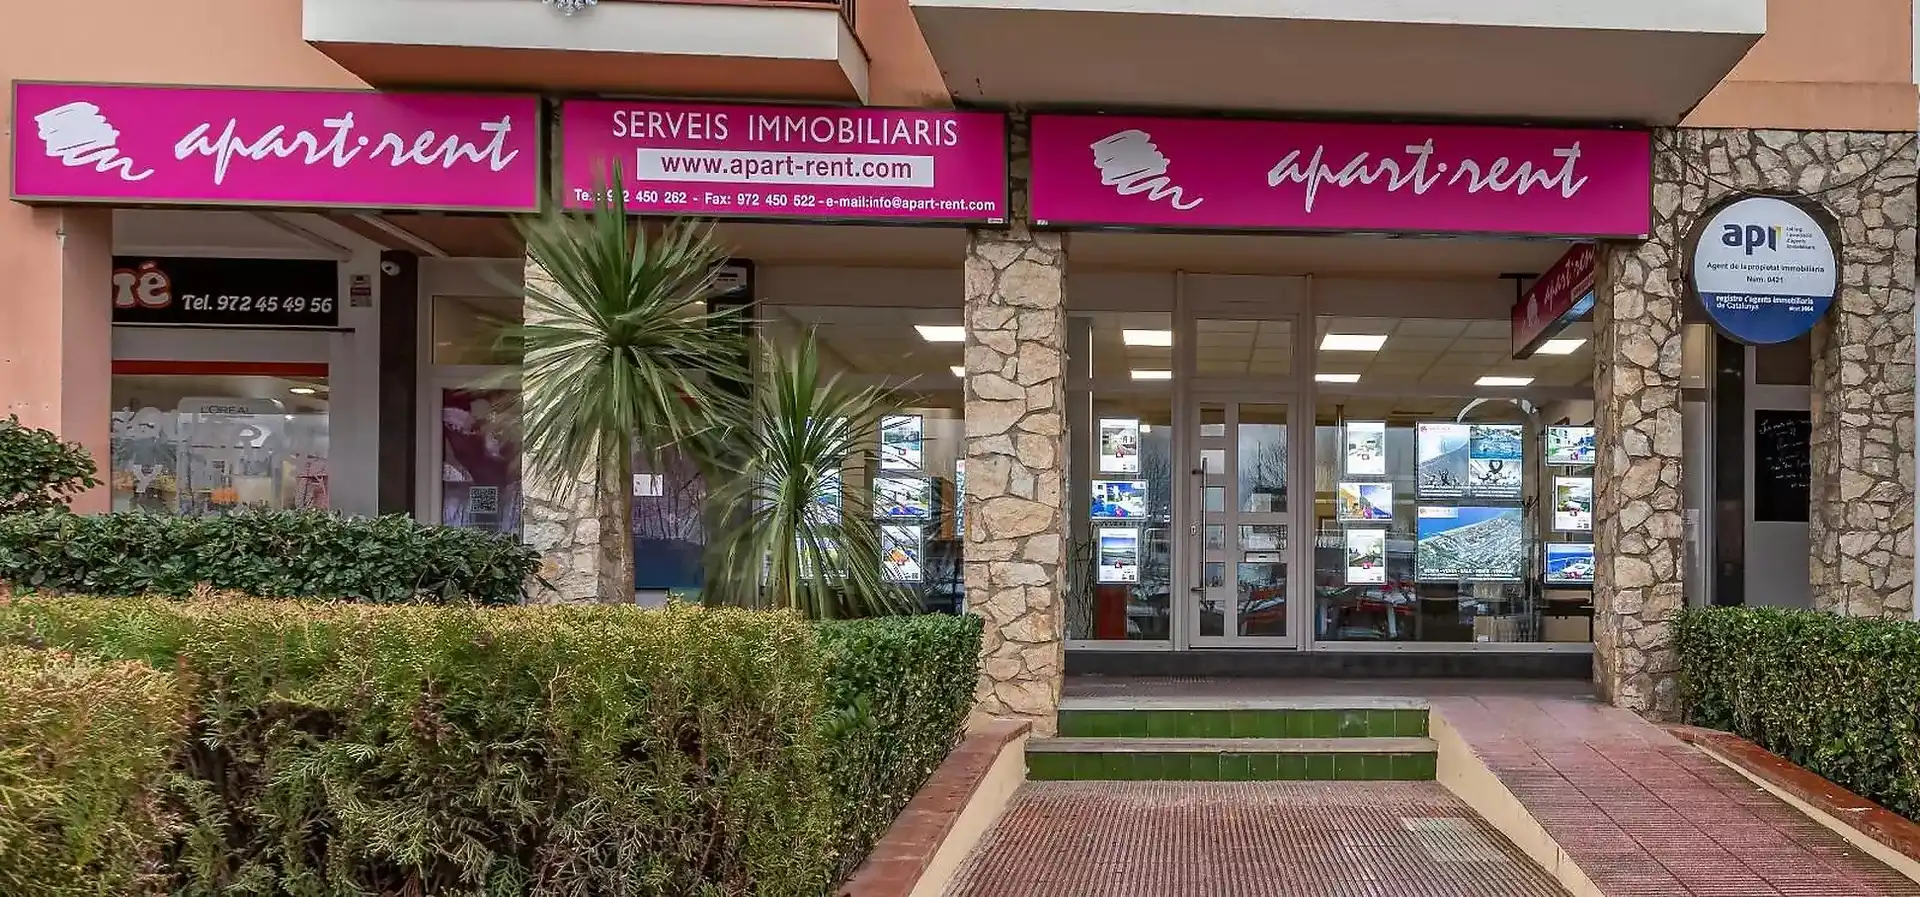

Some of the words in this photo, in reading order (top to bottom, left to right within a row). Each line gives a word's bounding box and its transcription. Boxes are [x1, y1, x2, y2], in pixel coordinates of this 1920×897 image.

[613, 110, 728, 140] SERVEIS
[749, 114, 957, 146] IMMOBILIARIS
[661, 155, 912, 178] www.apart-rent.com
[606, 189, 629, 202] 92
[636, 190, 658, 203] 450
[664, 191, 687, 204] 262
[705, 192, 731, 205] Fax:
[737, 193, 760, 206] 972
[765, 194, 787, 207] 450
[793, 194, 816, 207] 522
[1722, 225, 1782, 255] api
[1707, 262, 1729, 271] Agent
[182, 294, 213, 311] Tel.
[217, 295, 251, 311] 972
[255, 297, 278, 312] 45
[282, 297, 305, 312] 49
[310, 298, 332, 313] 56
